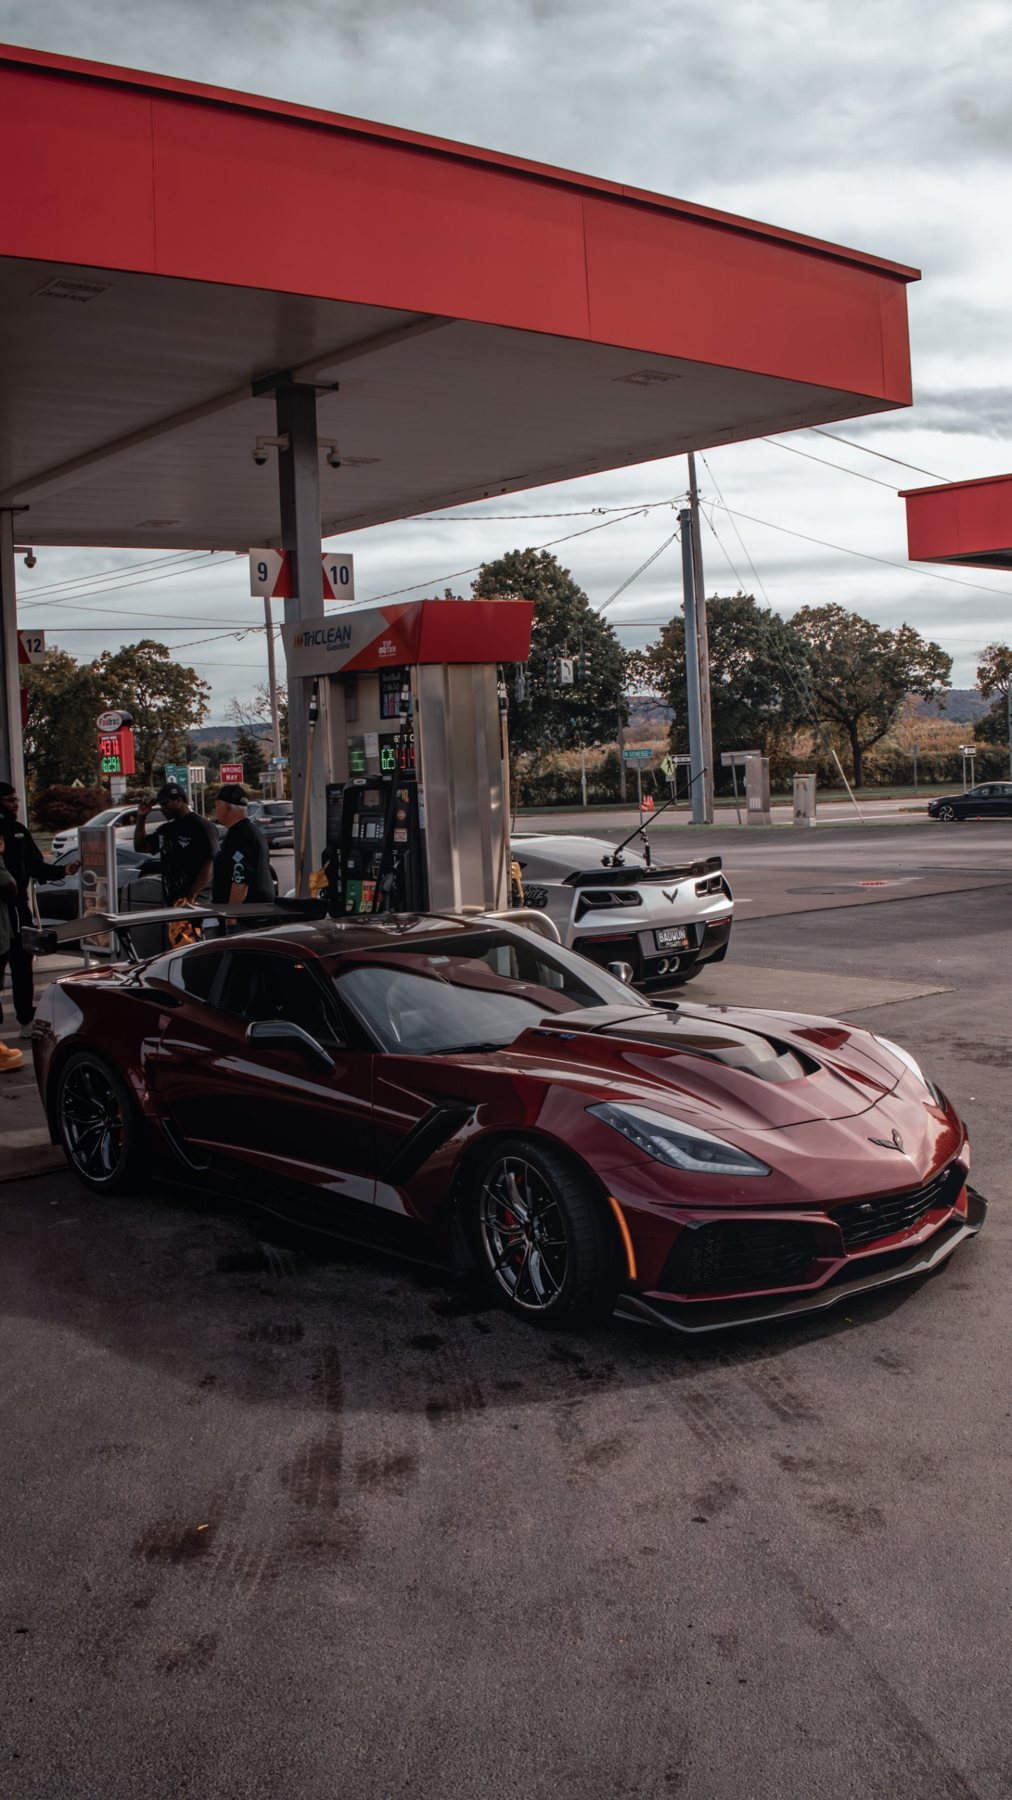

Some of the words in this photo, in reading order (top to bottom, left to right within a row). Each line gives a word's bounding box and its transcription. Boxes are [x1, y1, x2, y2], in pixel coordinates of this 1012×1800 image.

[257, 562, 268, 582] 9
[330, 565, 350, 585] 10
[26, 638, 42, 653] 12
